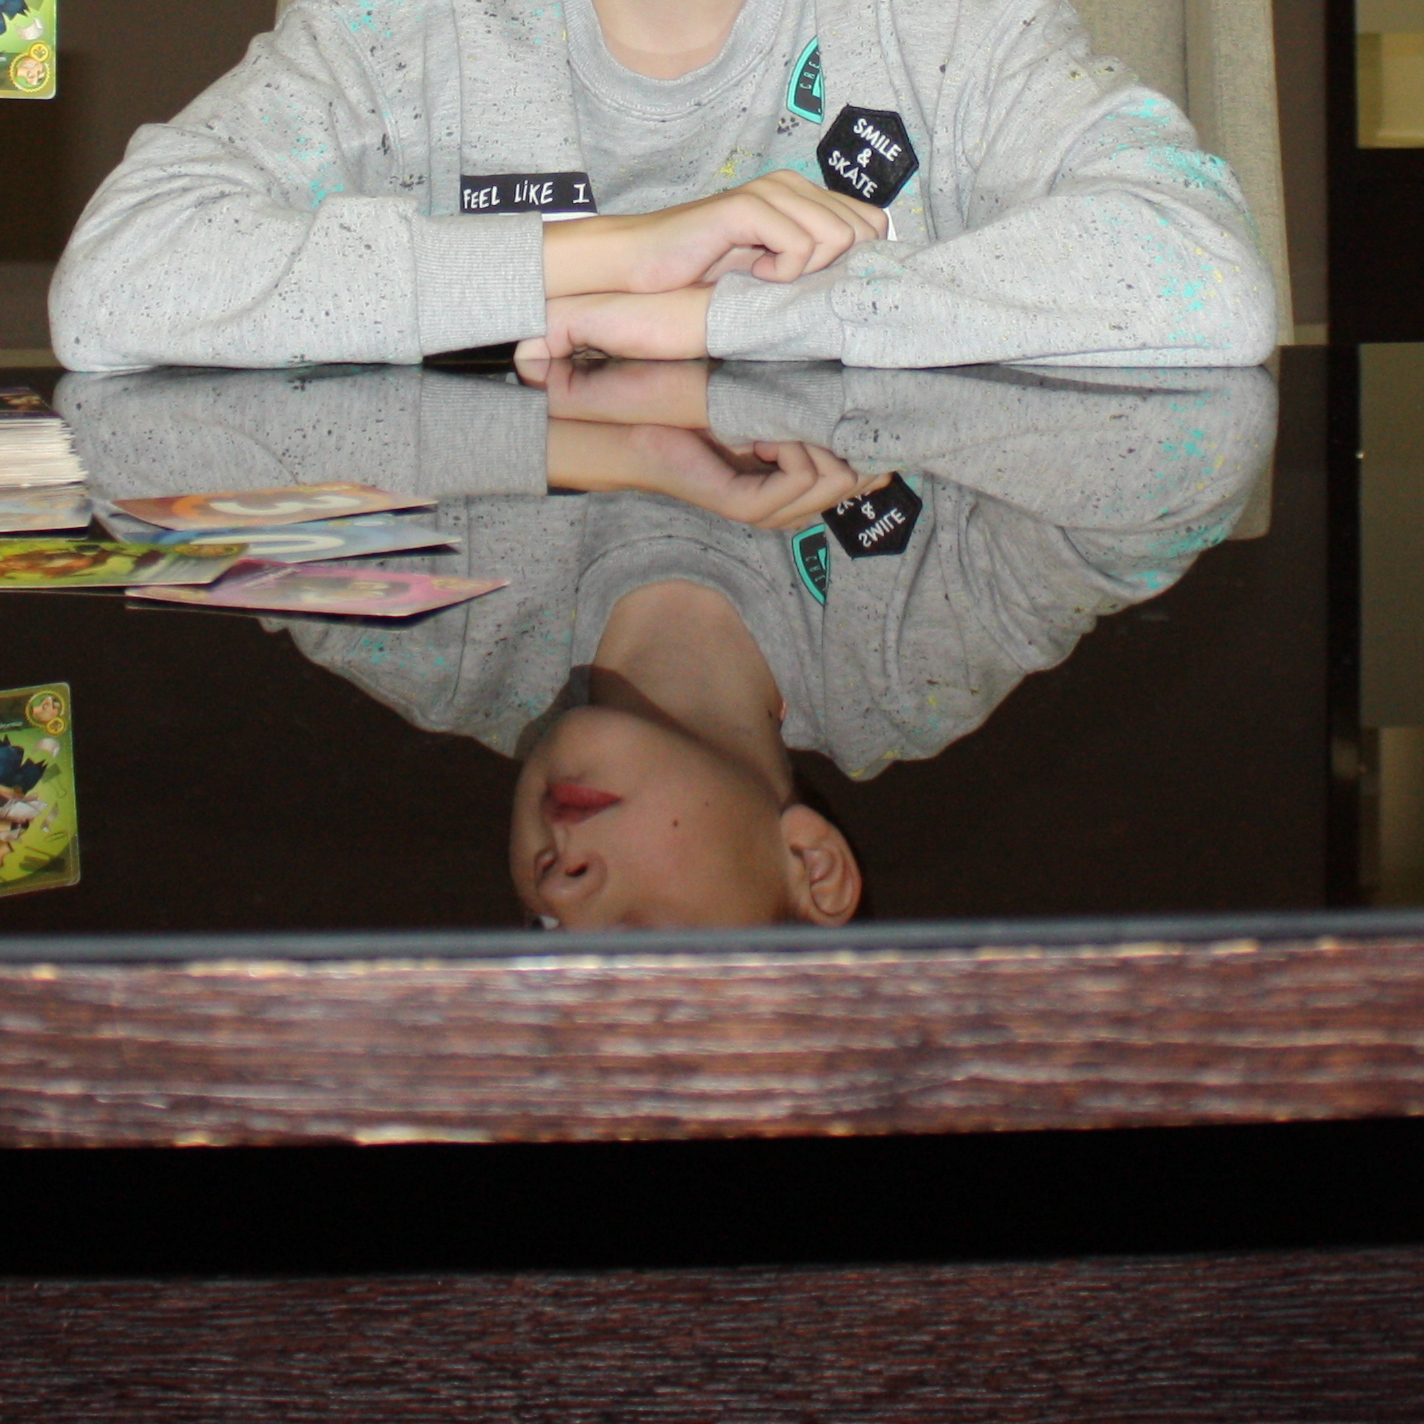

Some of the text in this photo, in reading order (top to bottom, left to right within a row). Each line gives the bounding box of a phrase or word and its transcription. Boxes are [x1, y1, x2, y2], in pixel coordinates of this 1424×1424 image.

[853, 118, 902, 162] SMILE
[857, 147, 872, 168] &
[828, 150, 878, 198] SKATE
[463, 185, 501, 209] FEEL
[573, 182, 590, 204] I
